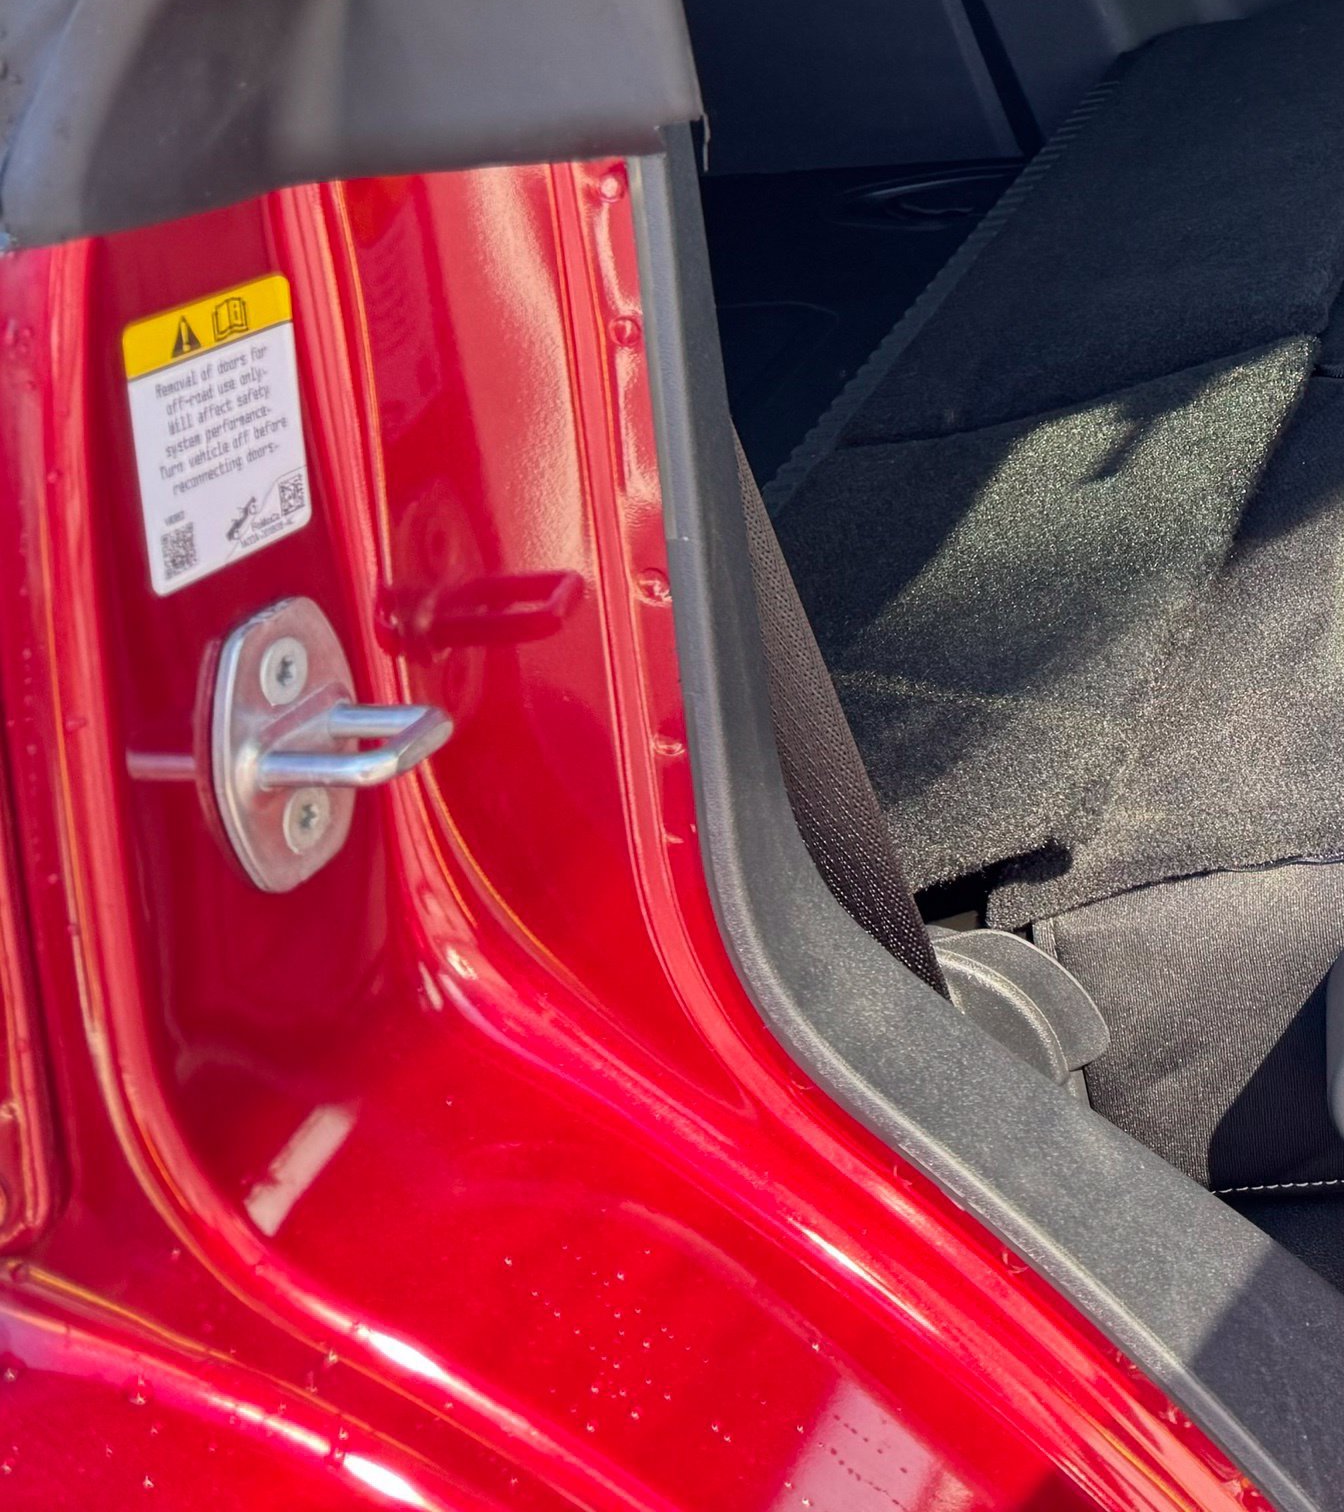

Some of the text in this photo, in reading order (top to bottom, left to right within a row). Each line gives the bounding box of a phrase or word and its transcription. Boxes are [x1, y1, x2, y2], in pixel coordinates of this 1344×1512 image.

[155, 345, 267, 399] Removal of doors for
[167, 384, 214, 416] off-road
[217, 378, 236, 395] use
[168, 384, 270, 436] Will affect safety
[160, 416, 288, 480] Turn vehicle off before
[165, 433, 202, 459] system
[172, 455, 243, 496] reconnecting
